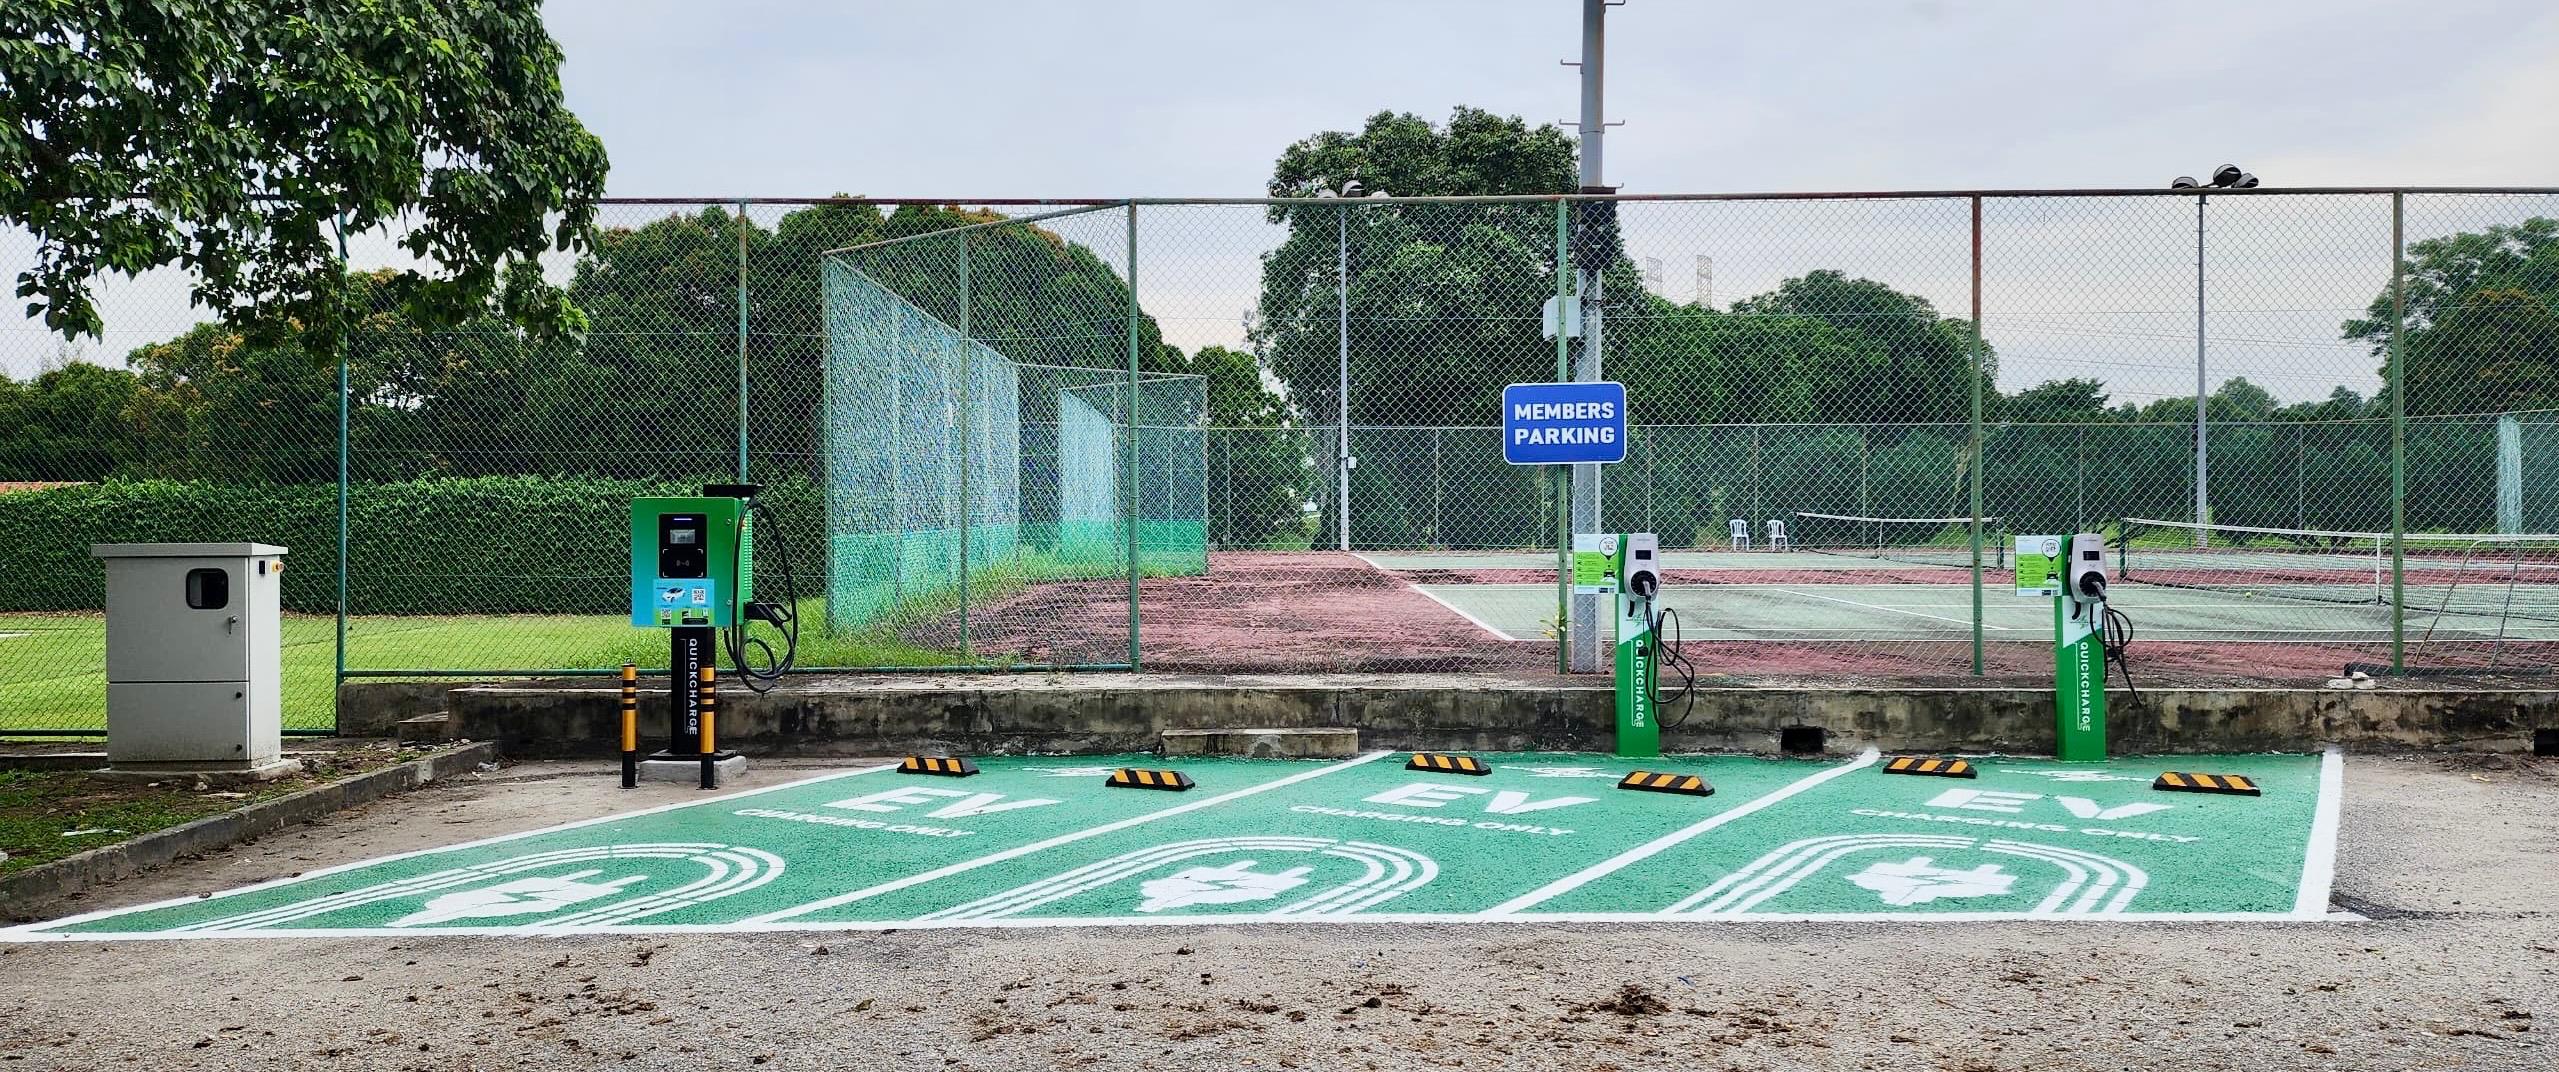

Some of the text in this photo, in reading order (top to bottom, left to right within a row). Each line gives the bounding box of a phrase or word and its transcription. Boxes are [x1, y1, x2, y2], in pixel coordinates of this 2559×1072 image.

[1514, 402, 1615, 420] MEMBERS
[1514, 427, 1615, 445] PARKING
[689, 638, 698, 735] QUICKCHARGE
[2080, 641, 2091, 732] QUICKCHARGE
[822, 786, 1060, 819] EV
[1361, 783, 1600, 815] EV
[1924, 788, 2174, 820] EV
[732, 808, 976, 838] CHARGING ONLY
[1290, 805, 1575, 836] CHARGING ONLY
[1850, 808, 2202, 843] CHARGING ONLY
